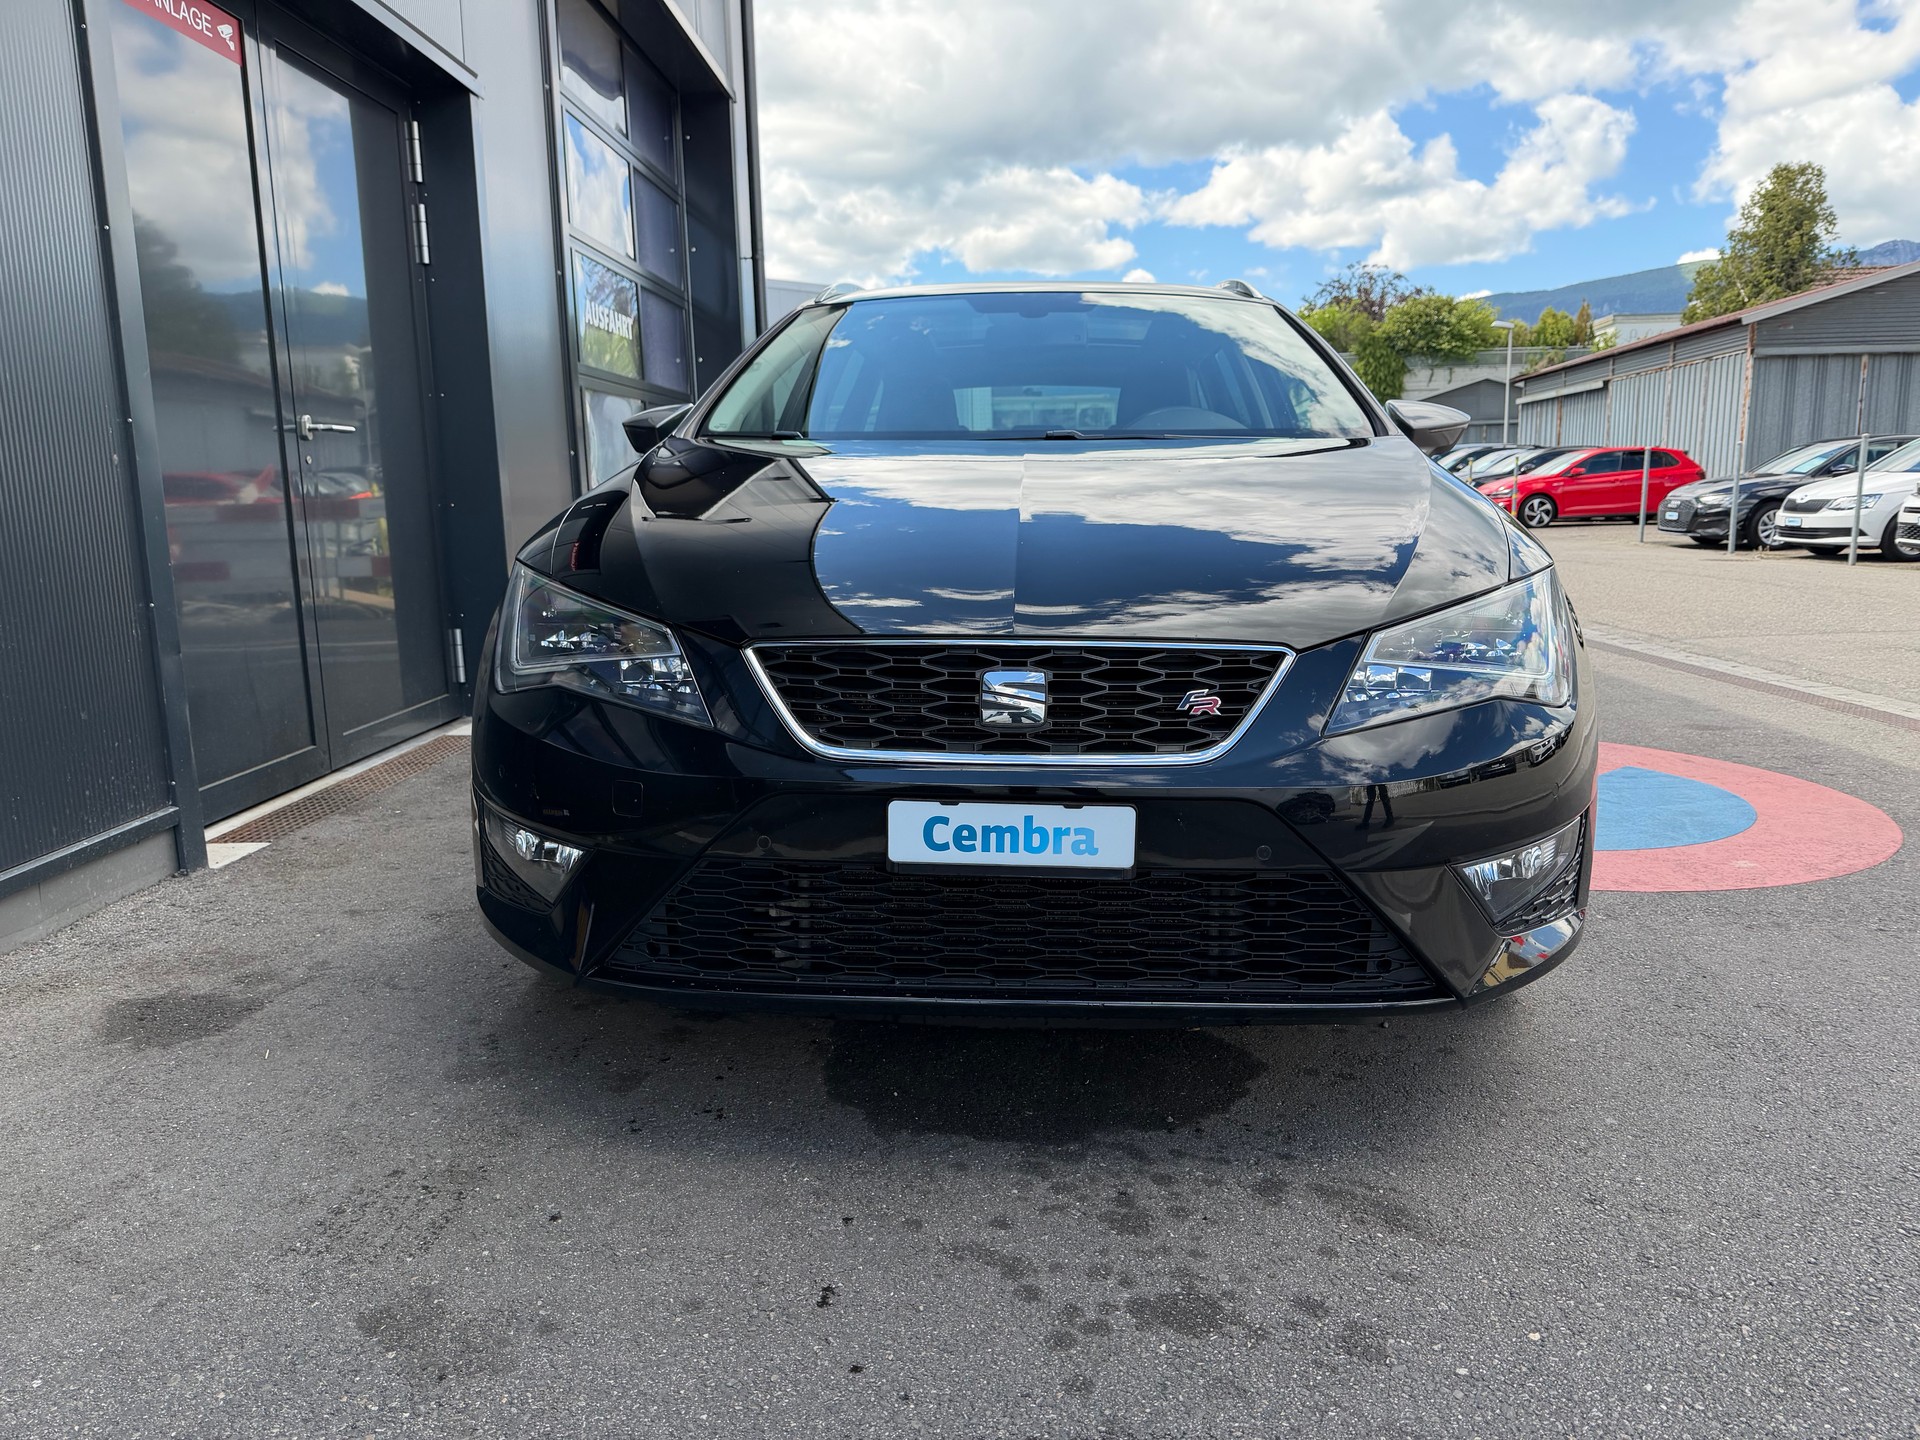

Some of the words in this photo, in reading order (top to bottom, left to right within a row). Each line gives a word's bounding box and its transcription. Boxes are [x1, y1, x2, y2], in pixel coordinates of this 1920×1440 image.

[147, 0, 213, 37] NLAGE
[585, 299, 633, 340] AUSFAHRT
[1176, 689, 1221, 715] FR
[922, 815, 1099, 856] Cembra
